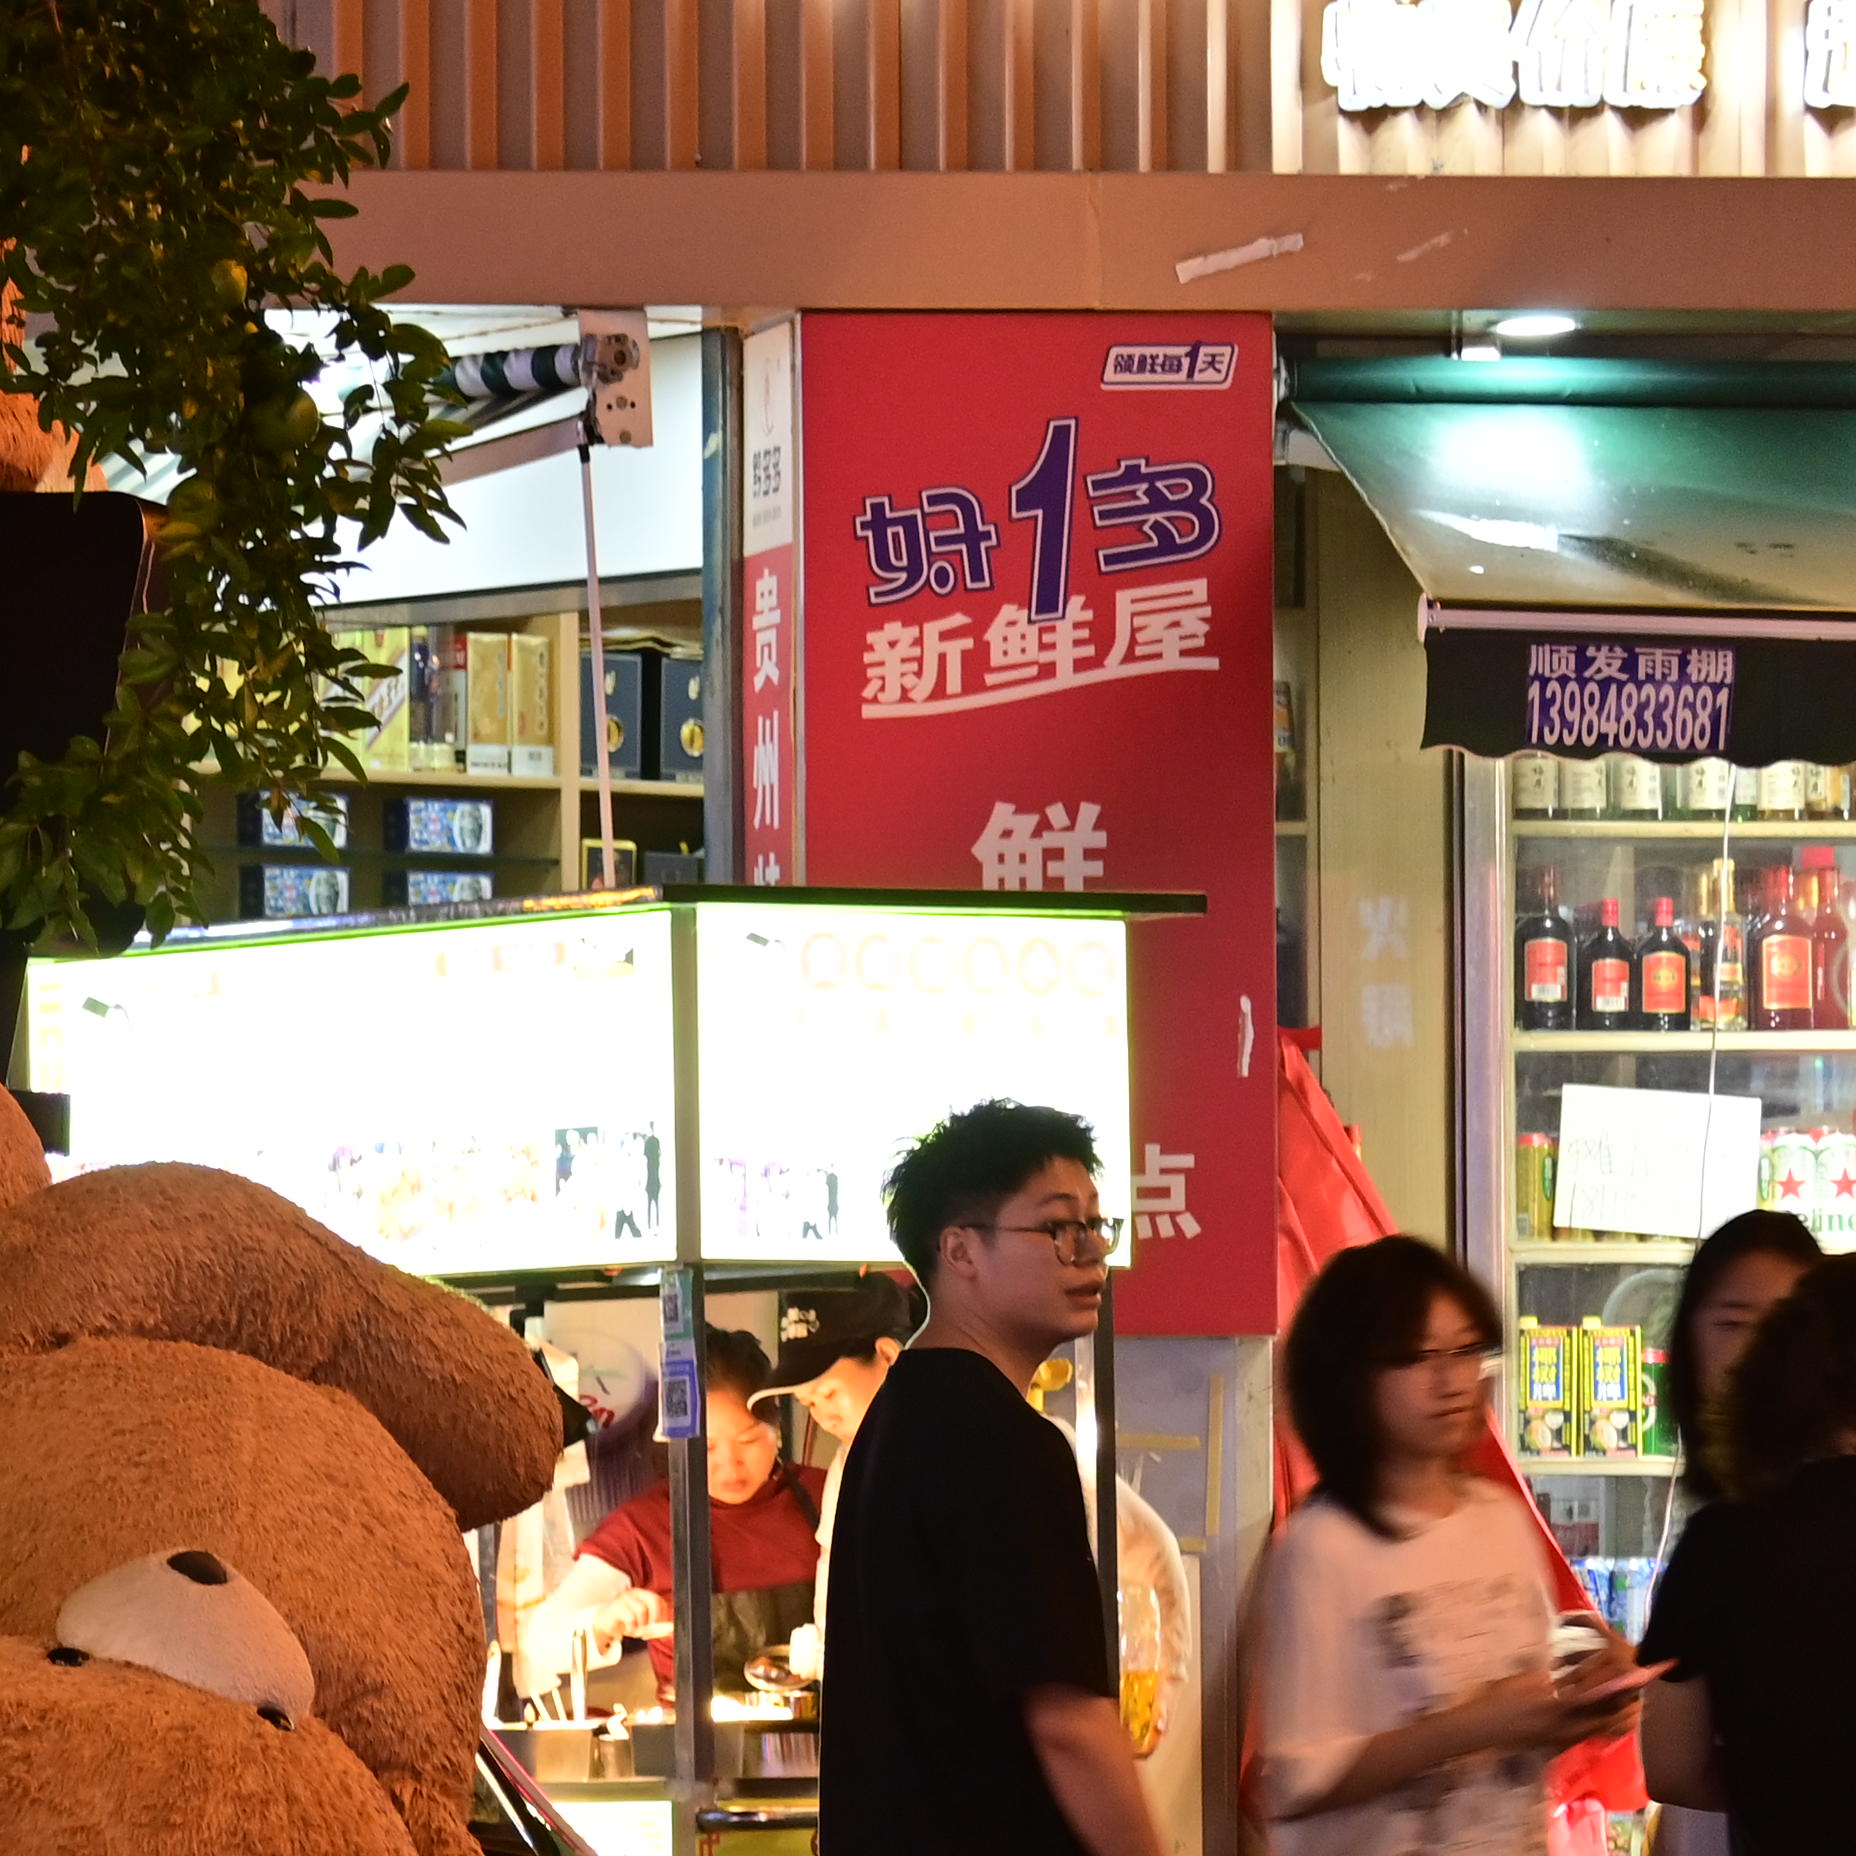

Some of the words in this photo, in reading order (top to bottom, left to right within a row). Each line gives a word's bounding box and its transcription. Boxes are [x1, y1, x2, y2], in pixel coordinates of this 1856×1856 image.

[861, 578, 1220, 704] 新鲜屋
[1528, 643, 1735, 684] 顺发雨棚
[1527, 681, 1730, 750] 13984833681
